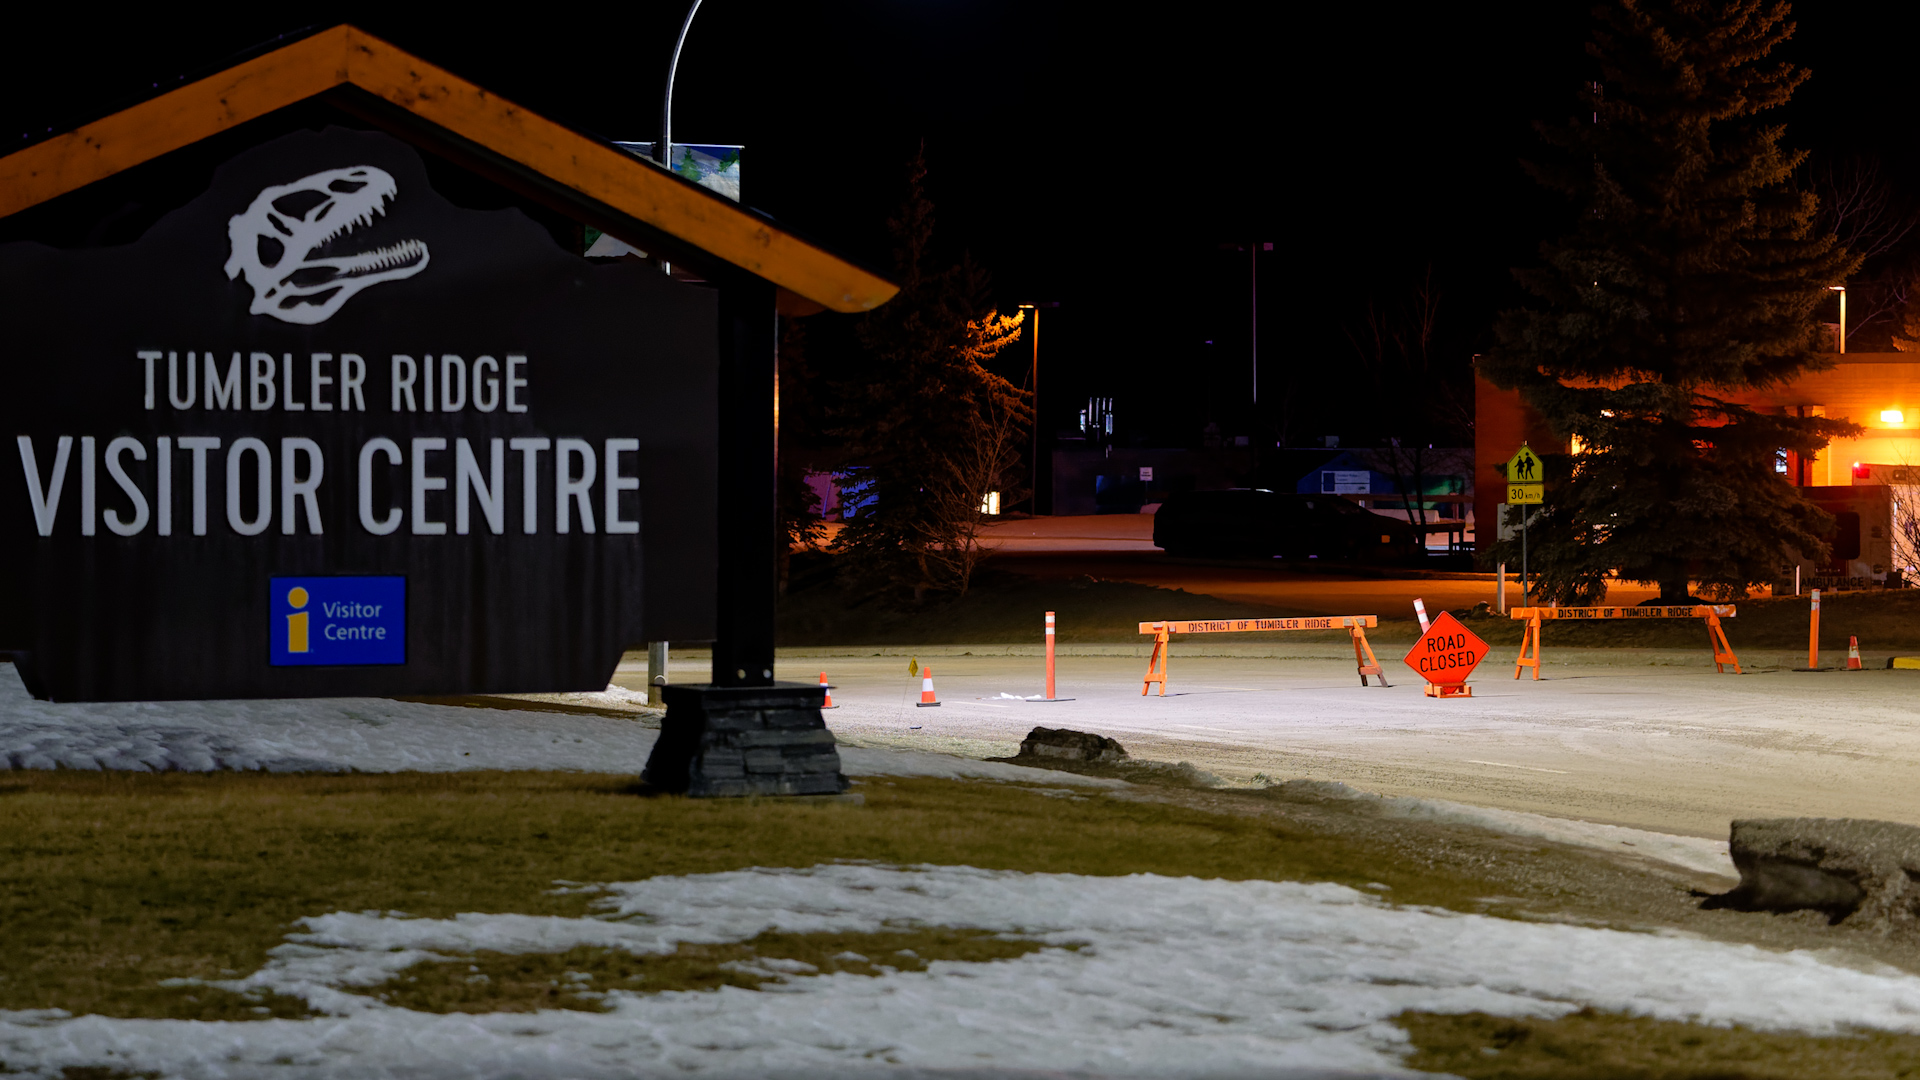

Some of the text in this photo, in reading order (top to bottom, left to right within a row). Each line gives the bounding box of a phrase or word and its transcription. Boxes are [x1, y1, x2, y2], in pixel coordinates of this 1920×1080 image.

[138, 351, 528, 413] TUMBLER RIDGE
[17, 435, 640, 537] VISITOR CENTRE
[1511, 488, 1523, 500] 30
[1801, 576, 1864, 588] AMBULANCE
[322, 601, 382, 618] Visitor
[1557, 607, 1693, 618] DISTRICT OF TUMBLER RIDGE
[324, 623, 386, 640] Centre
[1188, 618, 1332, 632] DISTRICT OF TUMBLER RIDGE
[1427, 633, 1466, 653] ROAD
[1420, 650, 1475, 673] CLOSED
